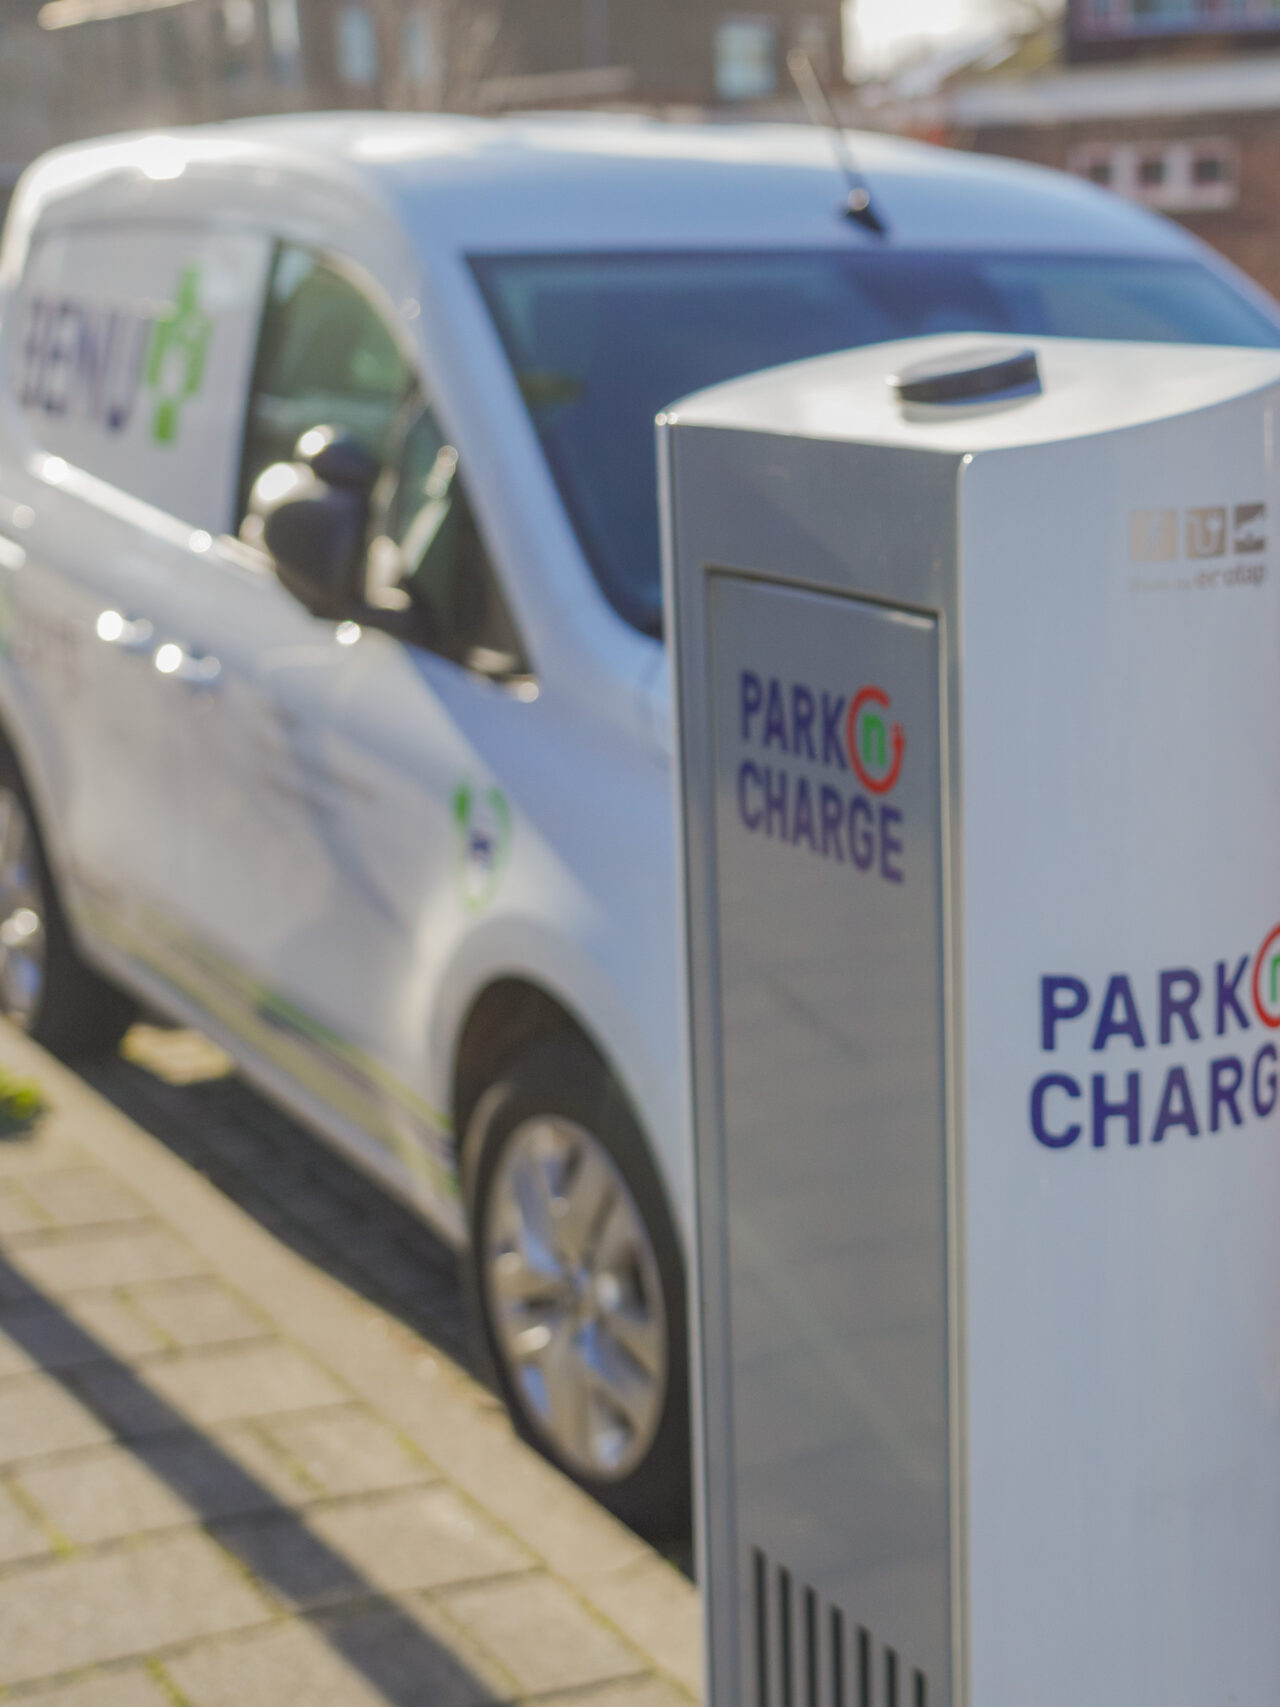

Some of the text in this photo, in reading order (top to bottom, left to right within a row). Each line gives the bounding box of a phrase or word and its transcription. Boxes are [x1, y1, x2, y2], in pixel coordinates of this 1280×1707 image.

[740, 669, 848, 772] PARK
[737, 759, 905, 885] CHARGE
[1040, 954, 1251, 1051] PARK
